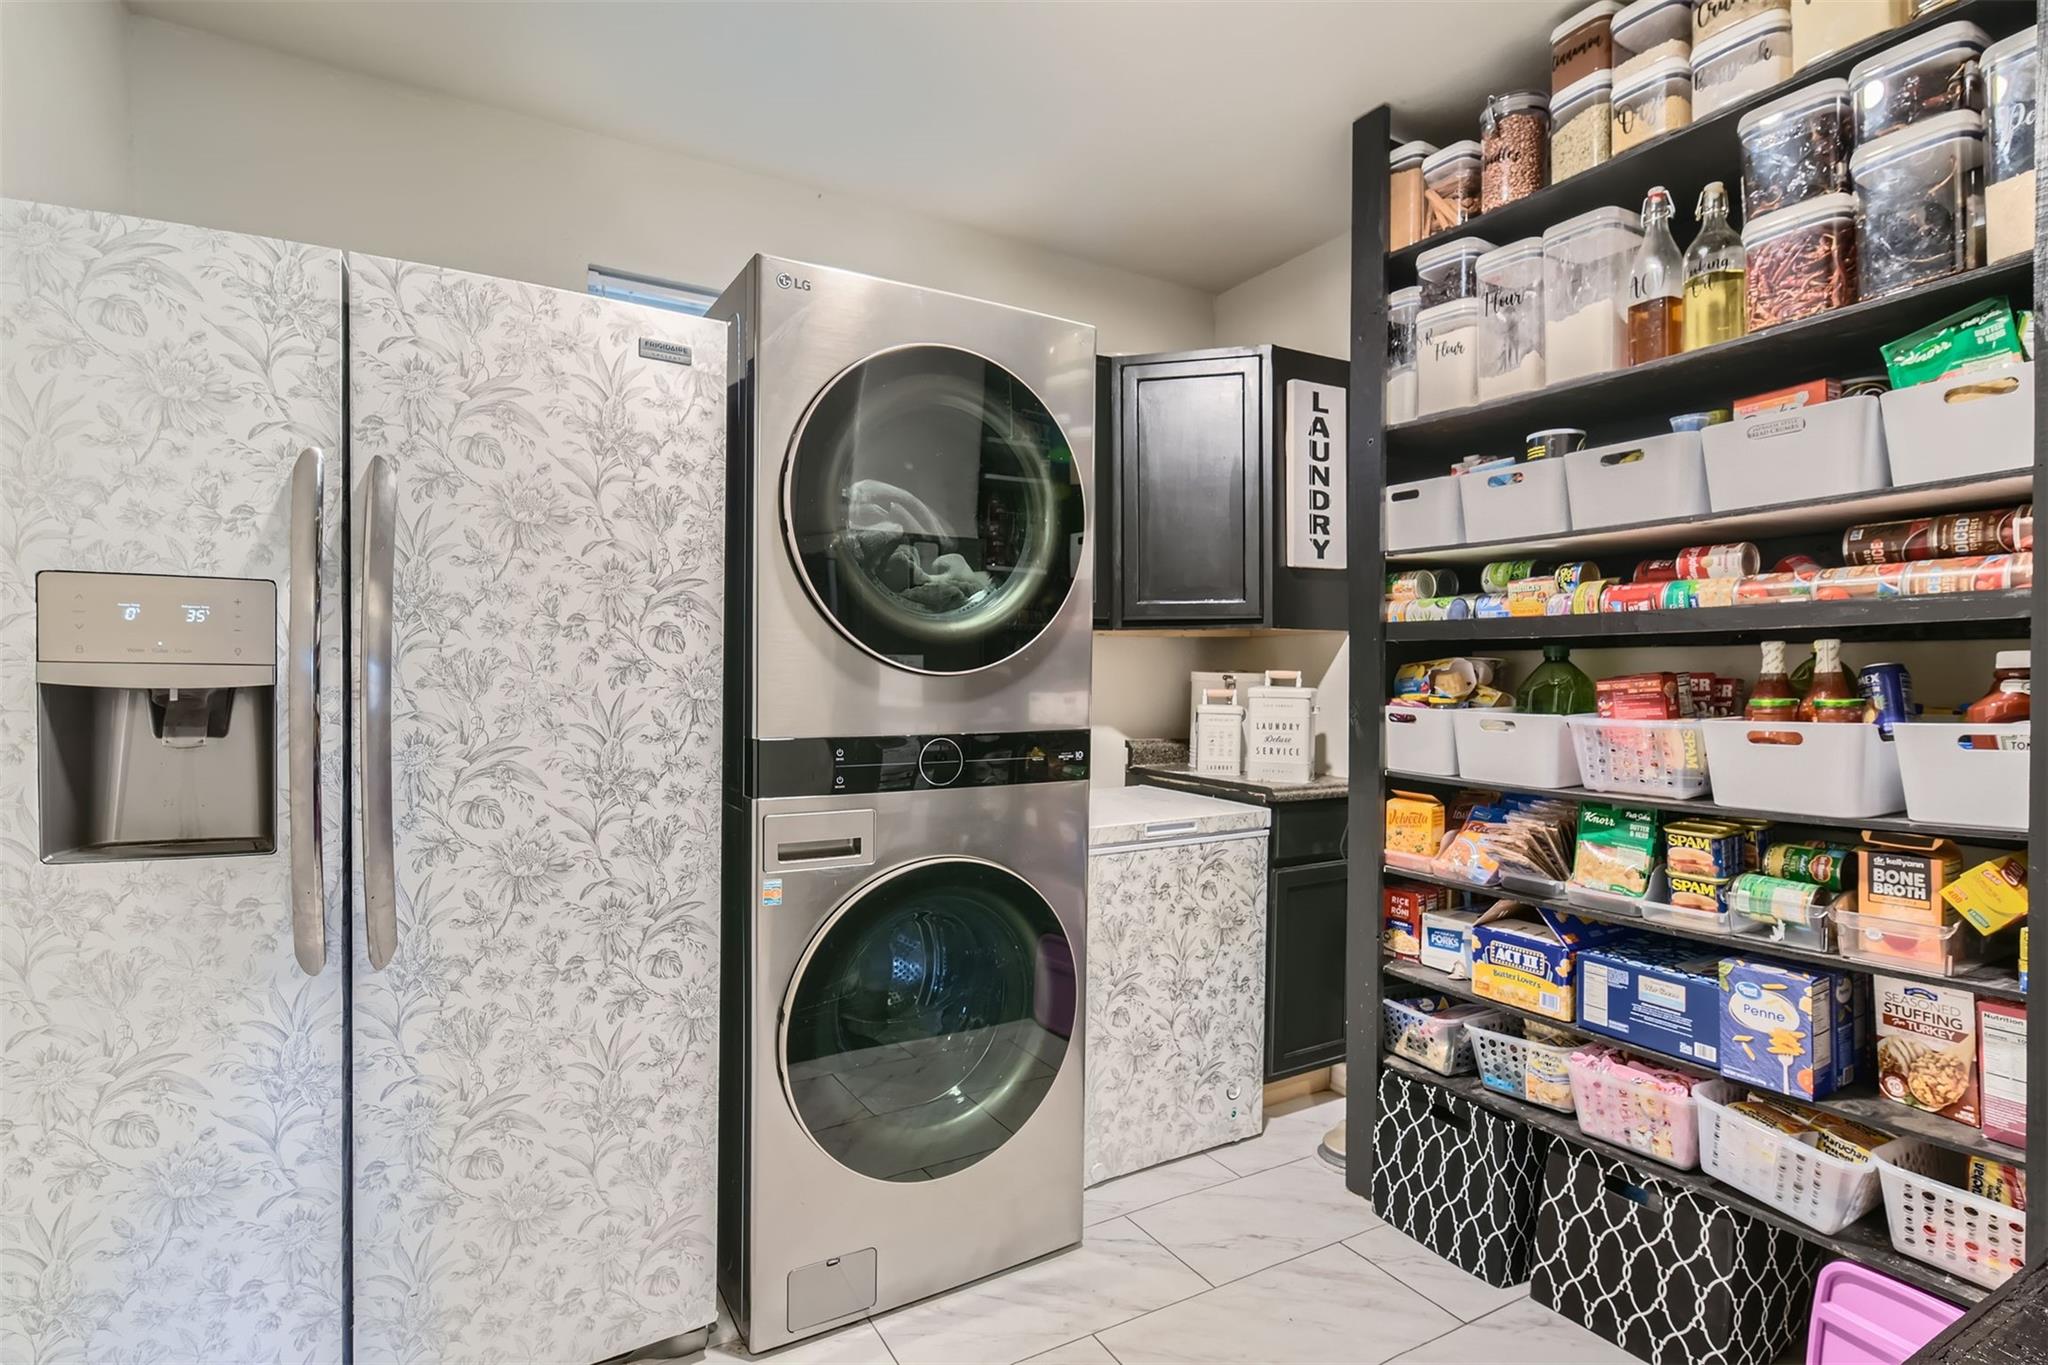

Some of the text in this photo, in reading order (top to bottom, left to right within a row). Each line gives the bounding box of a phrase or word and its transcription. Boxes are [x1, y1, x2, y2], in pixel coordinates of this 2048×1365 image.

[794, 277, 811, 291] LG
[1484, 291, 1523, 317] Flour
[1435, 341, 1466, 361] Flour
[1309, 390, 1330, 560] LAUNDRY
[1953, 517, 1971, 554] DICED
[1256, 722, 1300, 732] LAUNDRY
[1256, 746, 1300, 757] SERVICE
[1683, 730, 1699, 769] SPAM
[1387, 809, 1429, 826] Velveeta
[1584, 811, 1616, 827] Knorr
[1668, 834, 1711, 851] SPAM
[1886, 857, 1925, 869] kellyann
[1872, 867, 1926, 888] BONE
[1672, 879, 1715, 897] SPAM
[1872, 881, 1927, 900] BROTH
[1391, 895, 1410, 907] RICE
[1431, 933, 1460, 947] FORKS
[1495, 947, 1539, 970] ACT II
[1492, 969, 1542, 989] Butter Lovers
[1743, 1003, 1786, 1022] Penne
[1884, 991, 1962, 1017] SEASONED
[1884, 1001, 1963, 1030] STUFFING
[1983, 1012, 2024, 1026] Nutrition
[1905, 1020, 1955, 1040] TURKEY
[1821, 1132, 1869, 1163] Maruchan
